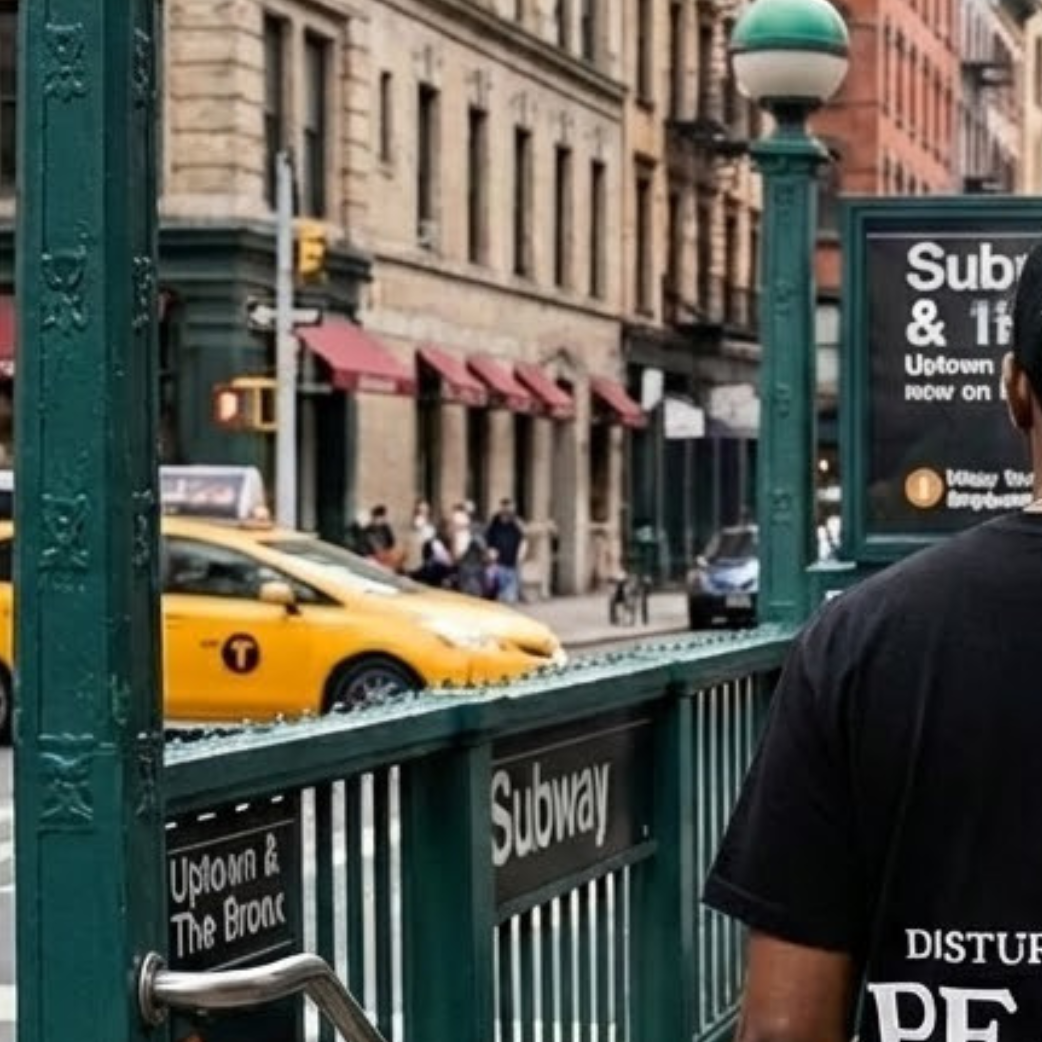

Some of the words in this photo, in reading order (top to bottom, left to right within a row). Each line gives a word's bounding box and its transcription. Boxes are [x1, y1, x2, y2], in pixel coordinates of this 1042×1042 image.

[906, 298, 947, 346] &
[962, 384, 992, 401] on
[491, 762, 610, 866] Subway
[170, 911, 217, 958] The
